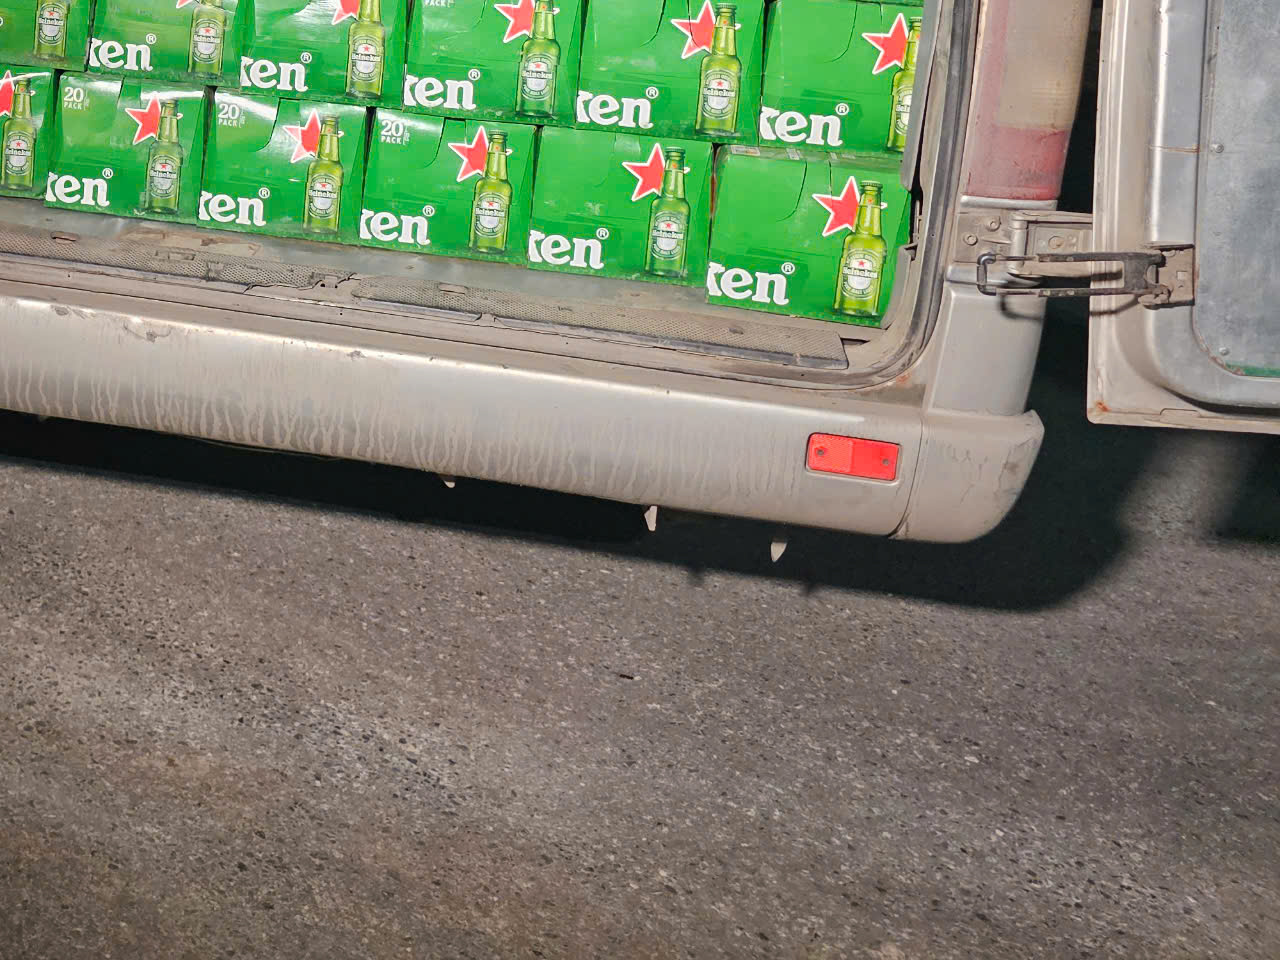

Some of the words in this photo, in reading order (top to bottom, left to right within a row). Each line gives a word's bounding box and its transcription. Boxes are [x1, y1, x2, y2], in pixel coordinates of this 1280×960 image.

[425, 0, 446, 7] PACK
[63, 86, 84, 102] 20
[218, 104, 240, 119] 20
[218, 119, 238, 127] PACK
[381, 119, 404, 136] 20
[381, 136, 402, 144] PACK
